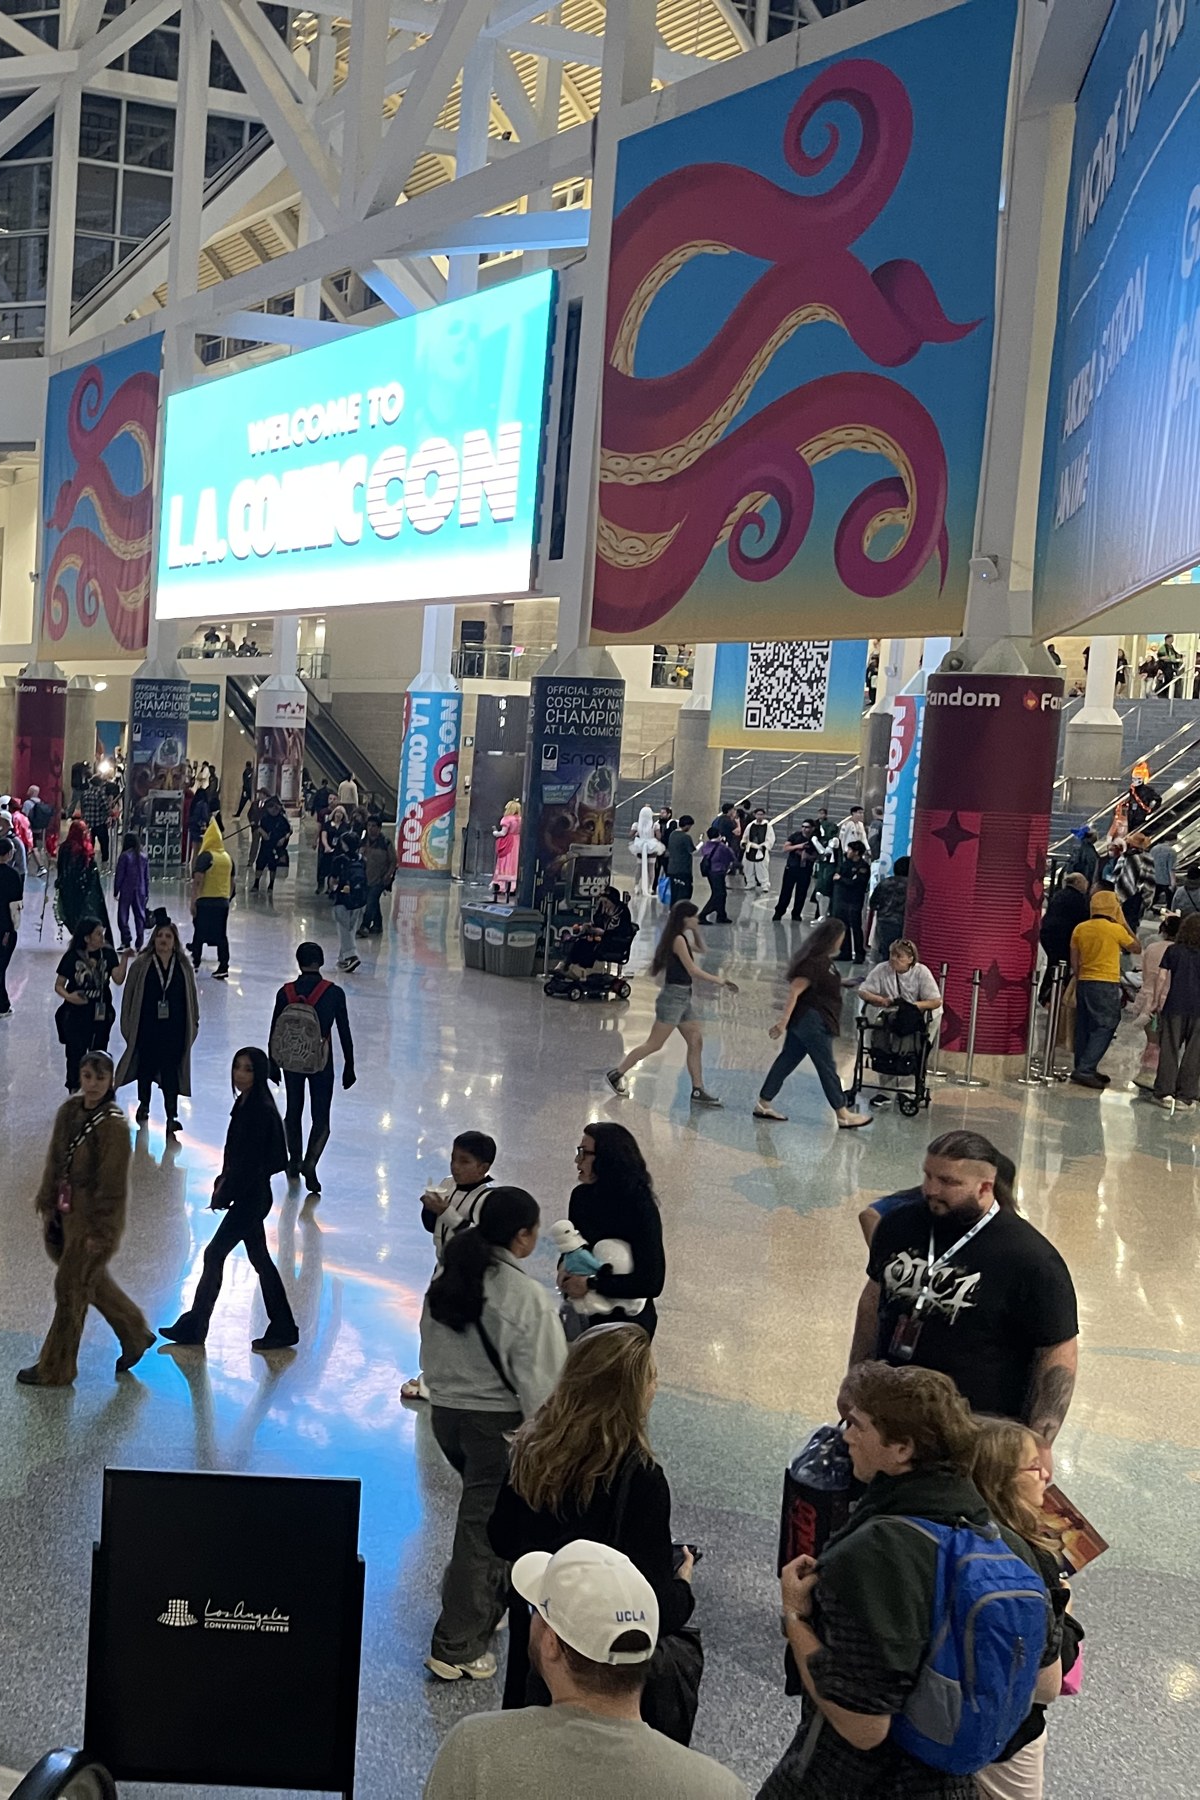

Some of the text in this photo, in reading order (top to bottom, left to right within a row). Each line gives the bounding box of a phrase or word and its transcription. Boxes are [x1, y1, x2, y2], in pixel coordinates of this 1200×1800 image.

[1121, 28, 1148, 153] TO
[247, 381, 405, 458] WELCOME TO
[167, 421, 522, 570] L.A. COMIC CON
[134, 691, 171, 701] COSPLAY
[547, 685, 590, 695] OFFICIAL
[546, 696, 605, 709] COSPLAY
[544, 724, 557, 734] AT
[582, 726, 614, 737] COMIC
[402, 697, 431, 864] L.A. COMIC CON
[204, 1598, 290, 1628] Los Angeles
[615, 1610, 646, 1622] UCLA
[204, 1621, 289, 1633] CONVENTION CENTER
